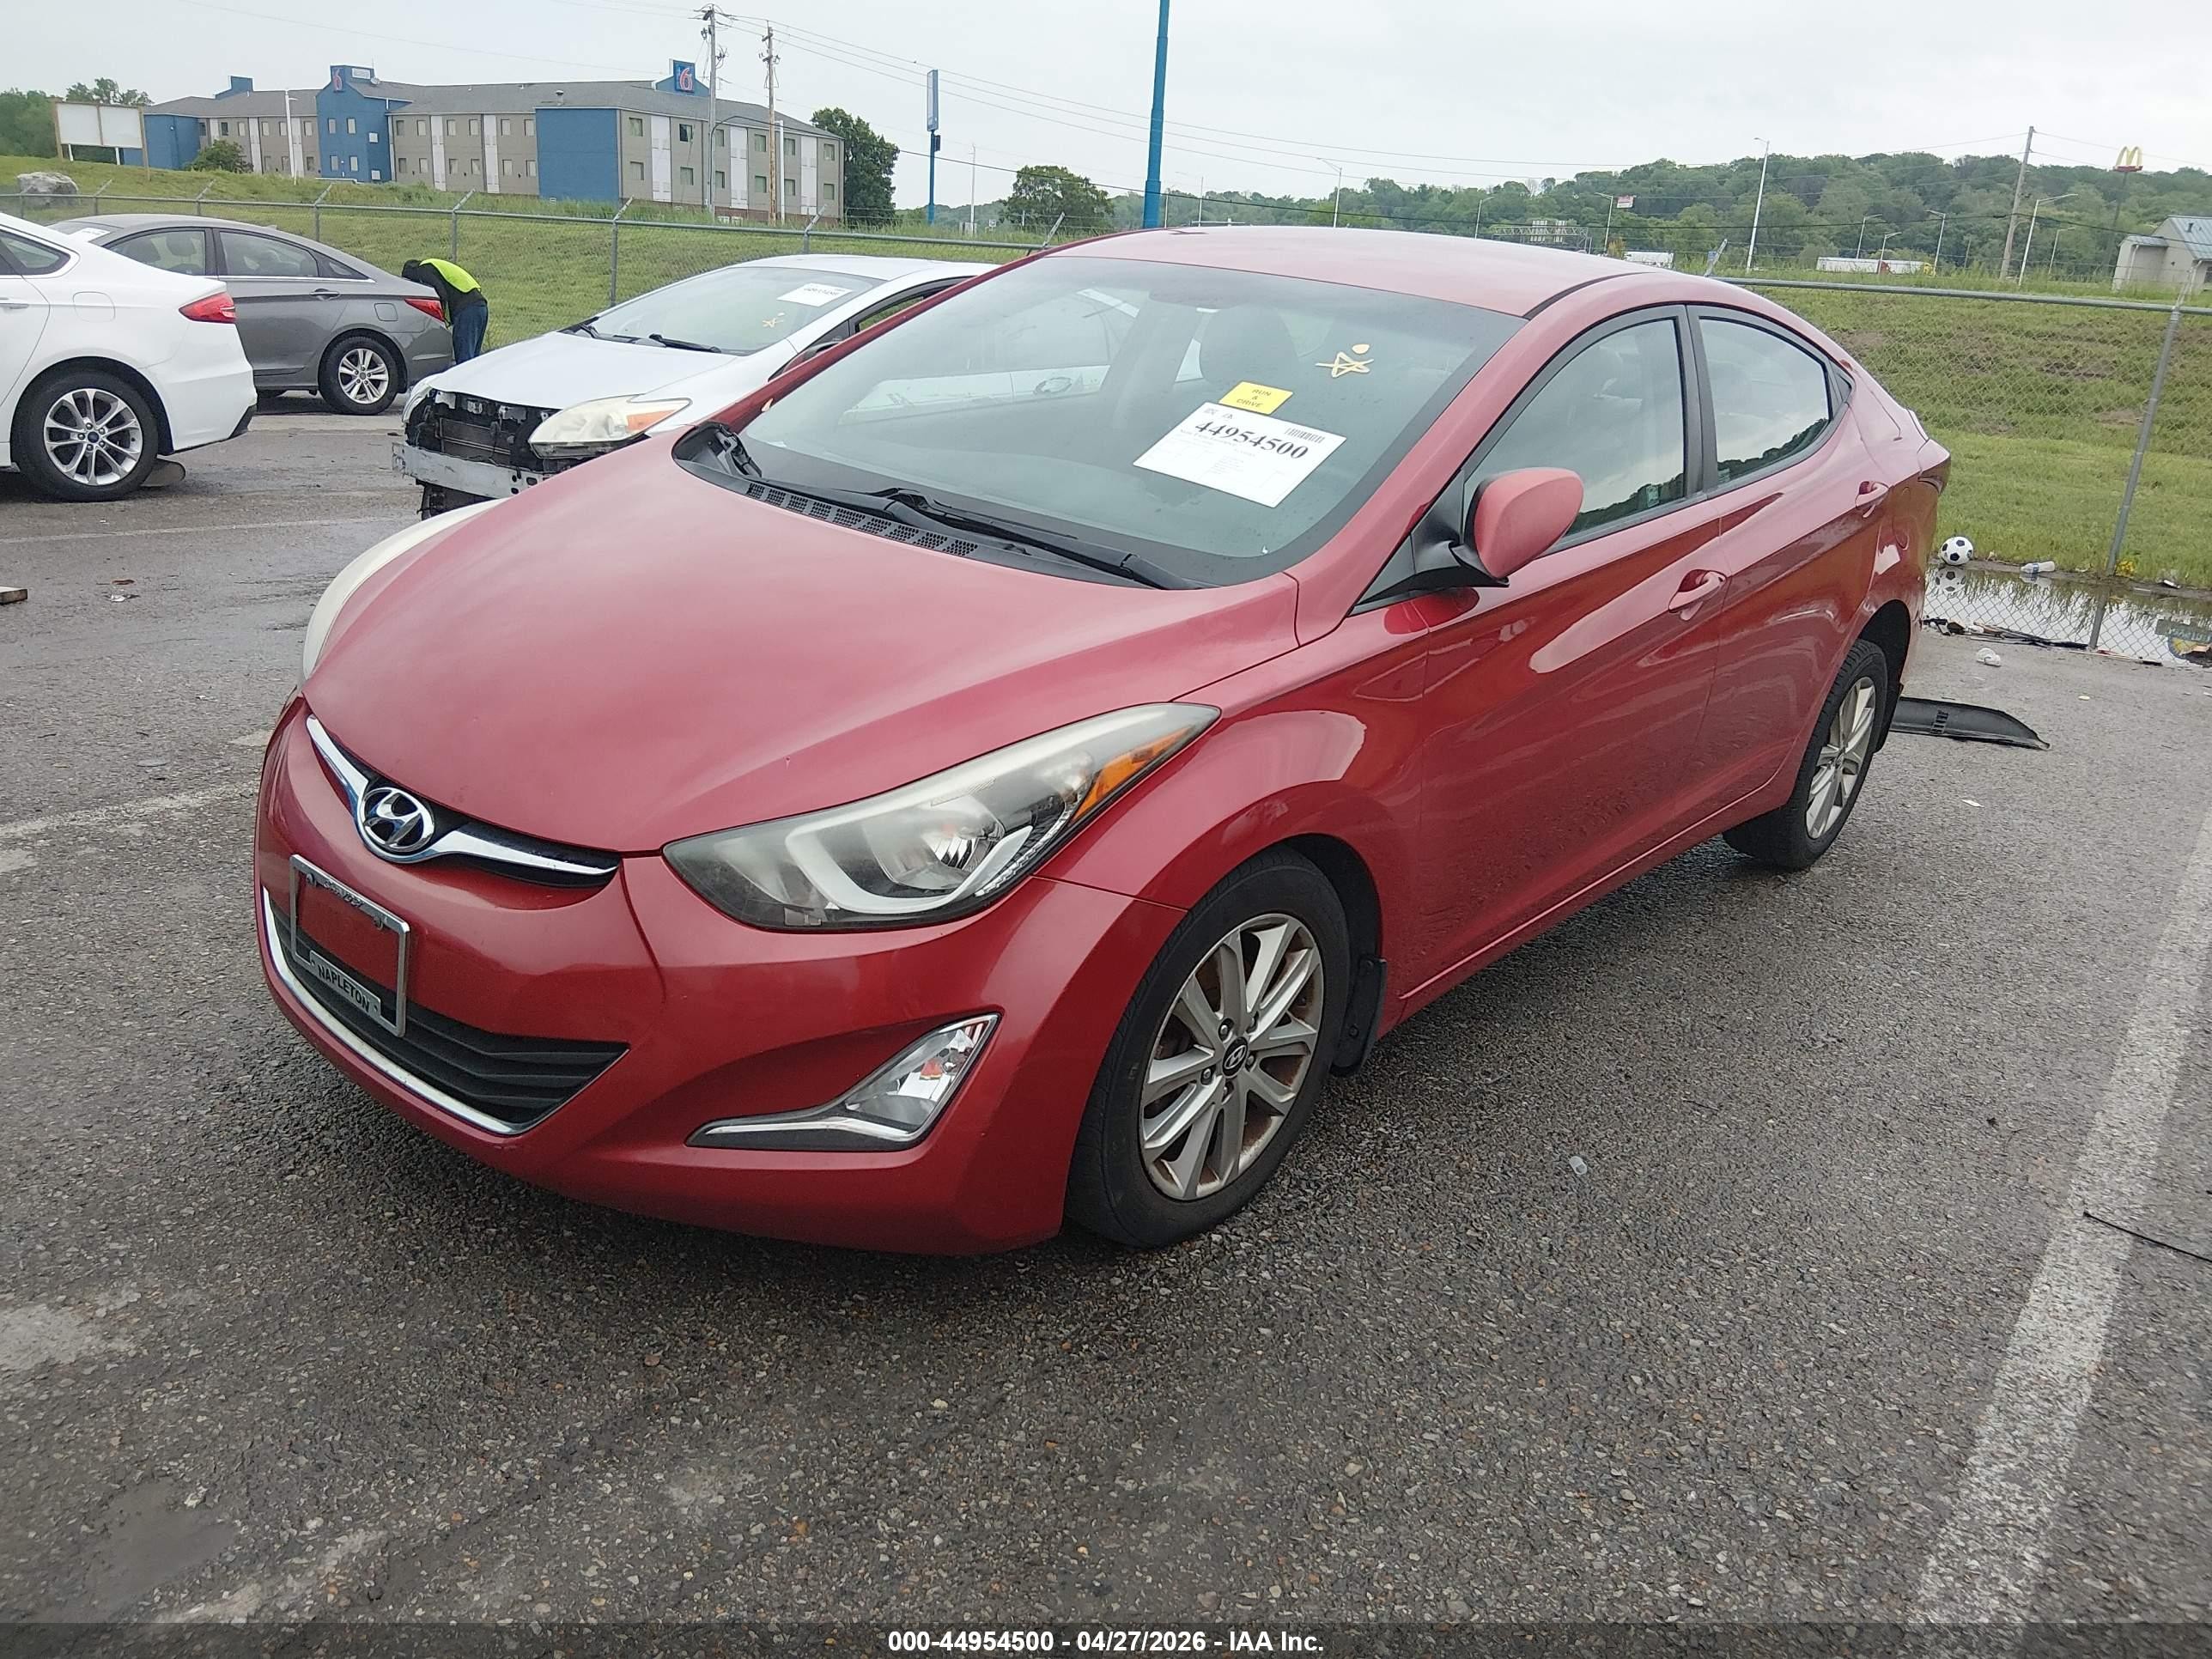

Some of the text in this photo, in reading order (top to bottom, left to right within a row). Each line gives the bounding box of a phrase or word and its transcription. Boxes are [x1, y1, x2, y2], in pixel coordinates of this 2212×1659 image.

[332, 68, 343, 91] 6
[679, 68, 693, 91] 6
[1236, 398, 1264, 408] DRIVE
[1194, 421, 1310, 459] 44954500
[318, 964, 371, 1012] NAPLETON
